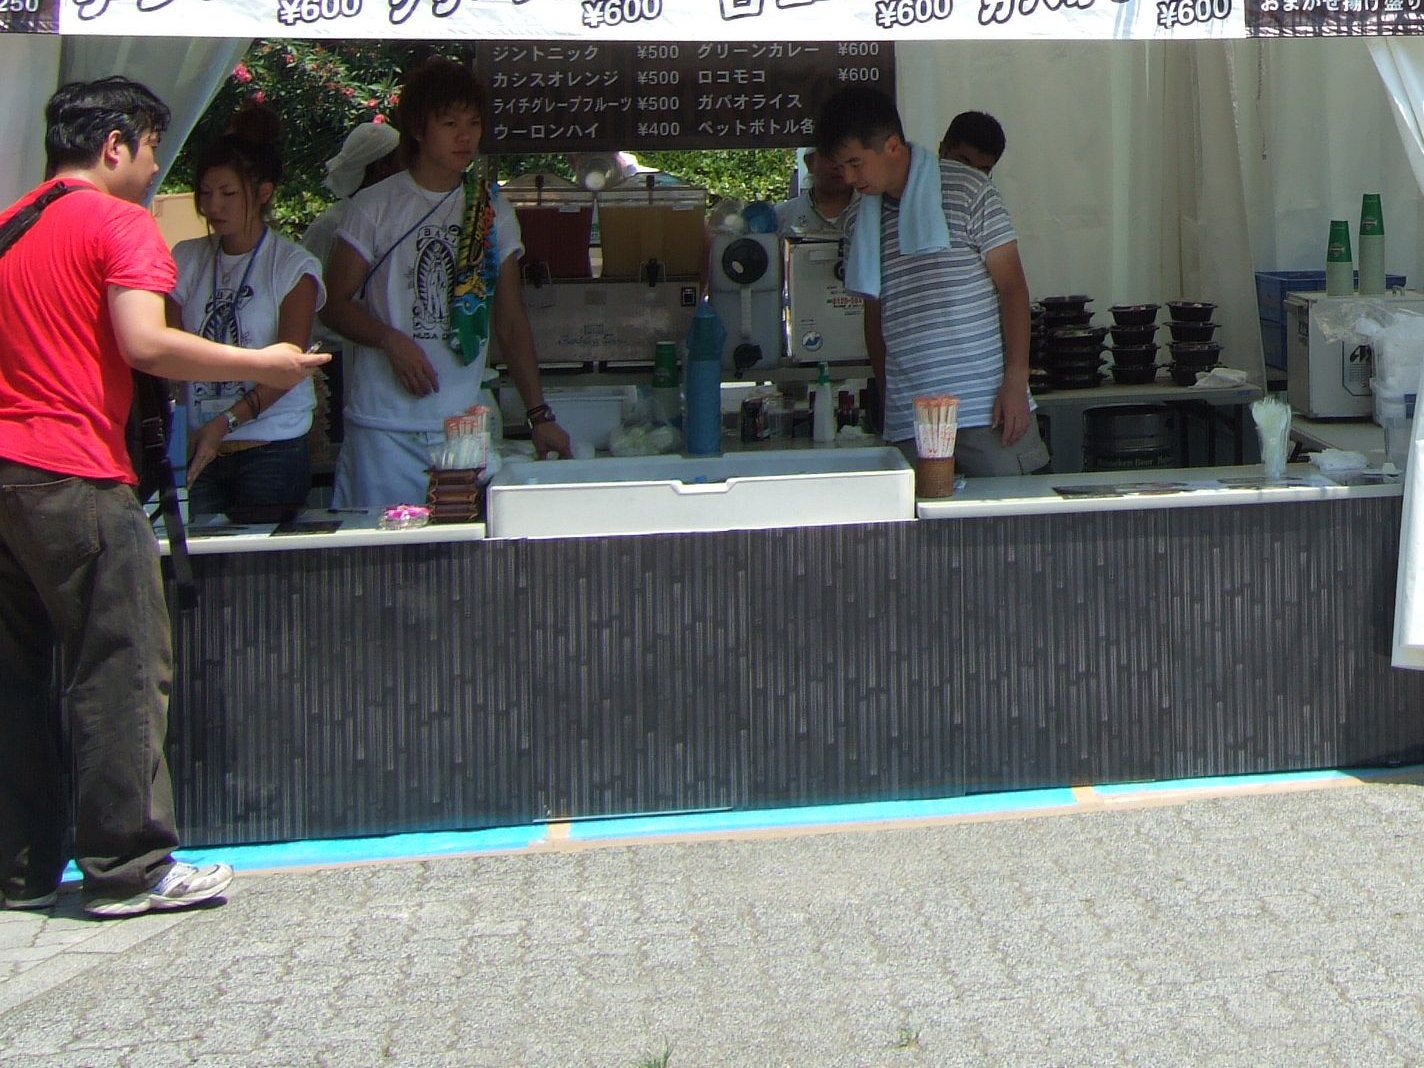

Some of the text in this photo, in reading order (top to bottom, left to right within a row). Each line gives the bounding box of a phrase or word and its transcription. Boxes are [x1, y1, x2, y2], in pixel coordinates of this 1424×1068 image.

[492, 43, 680, 63] ジントニック ¥500
[697, 41, 880, 61] グリーンカレー ¥600
[493, 69, 680, 88] カシスオレンジ ¥500
[698, 67, 880, 85] ロコモコ ¥600
[493, 95, 680, 116] ライチグレープフルーツ ¥500
[697, 92, 803, 111] ガパオライス
[494, 121, 680, 140] ウーロンハイ ¥400
